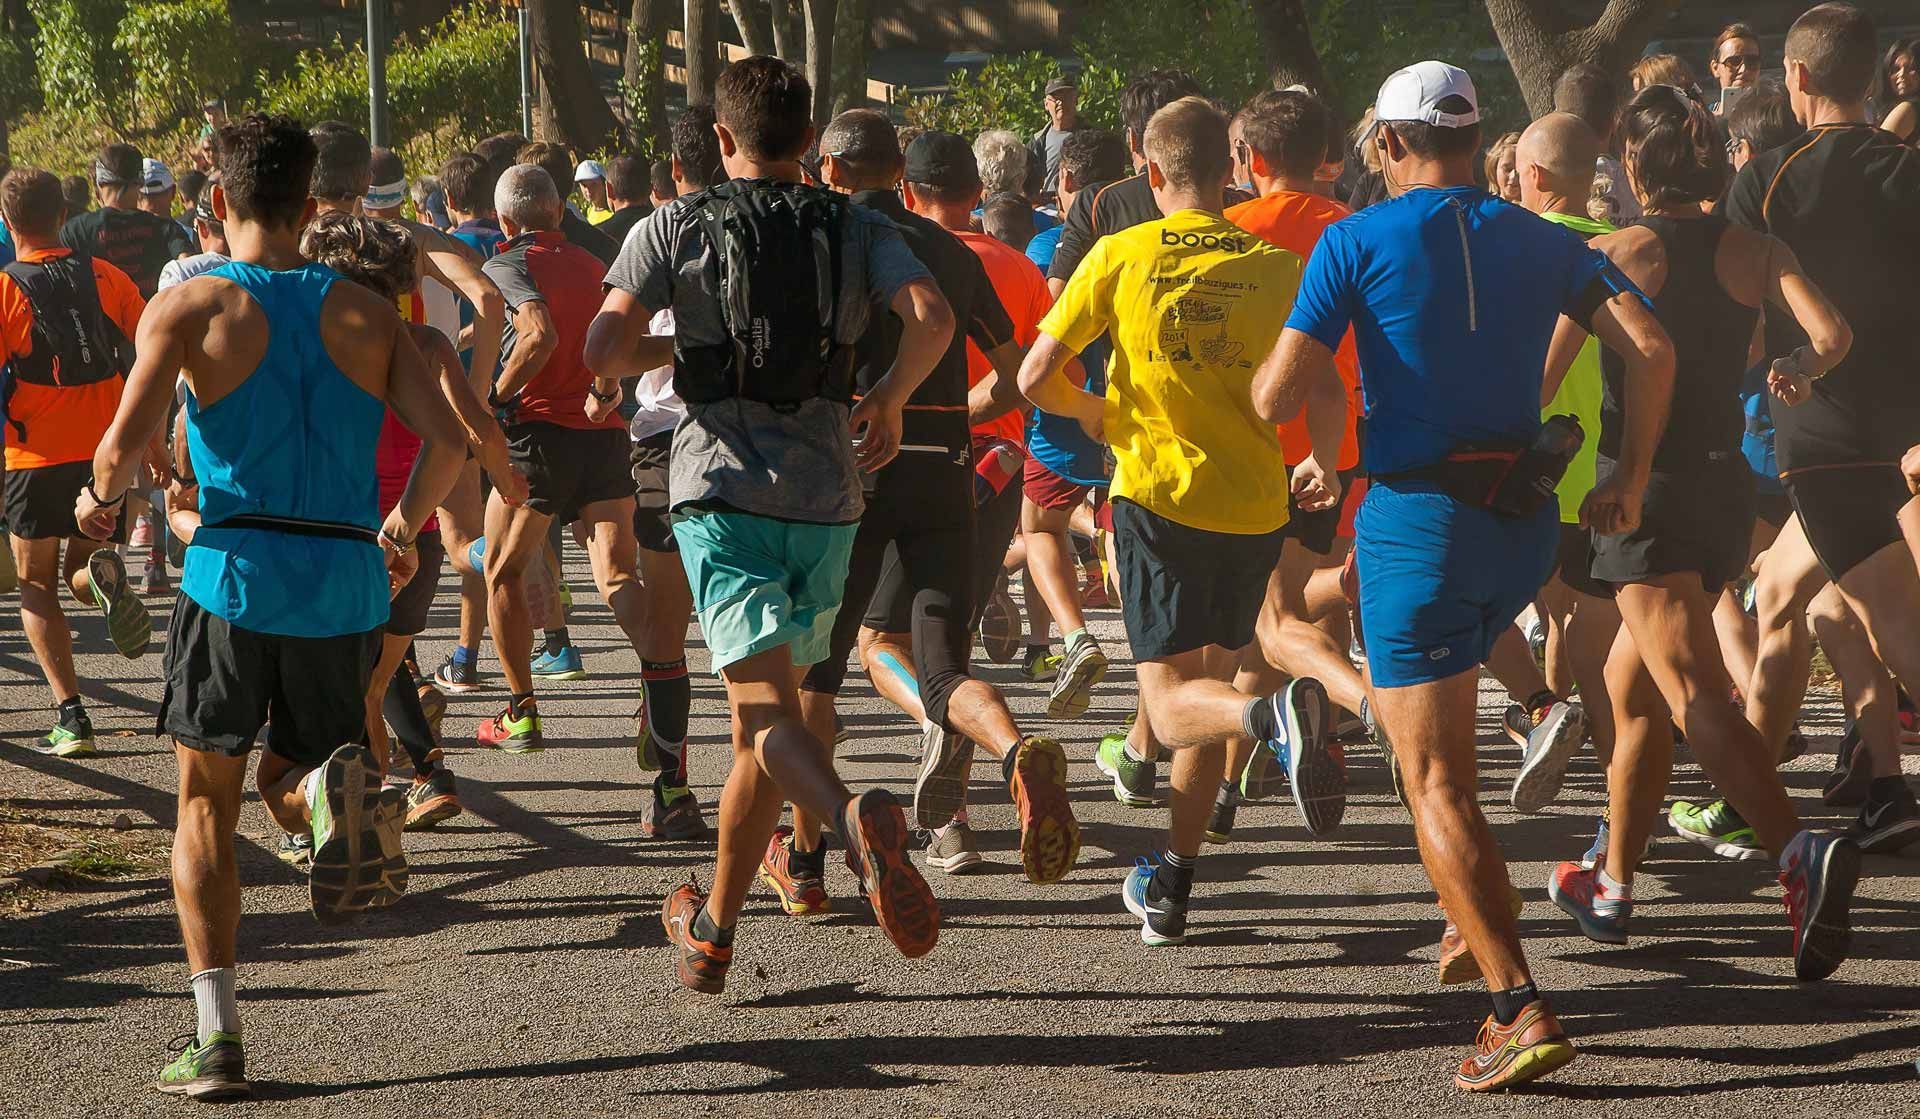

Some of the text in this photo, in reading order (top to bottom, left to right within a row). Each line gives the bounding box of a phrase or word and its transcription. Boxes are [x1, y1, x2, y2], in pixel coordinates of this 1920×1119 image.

[1161, 228, 1246, 254] boost
[1149, 275, 1259, 292] www.trailbouzigues.fr
[752, 318, 763, 368] Oxsitis
